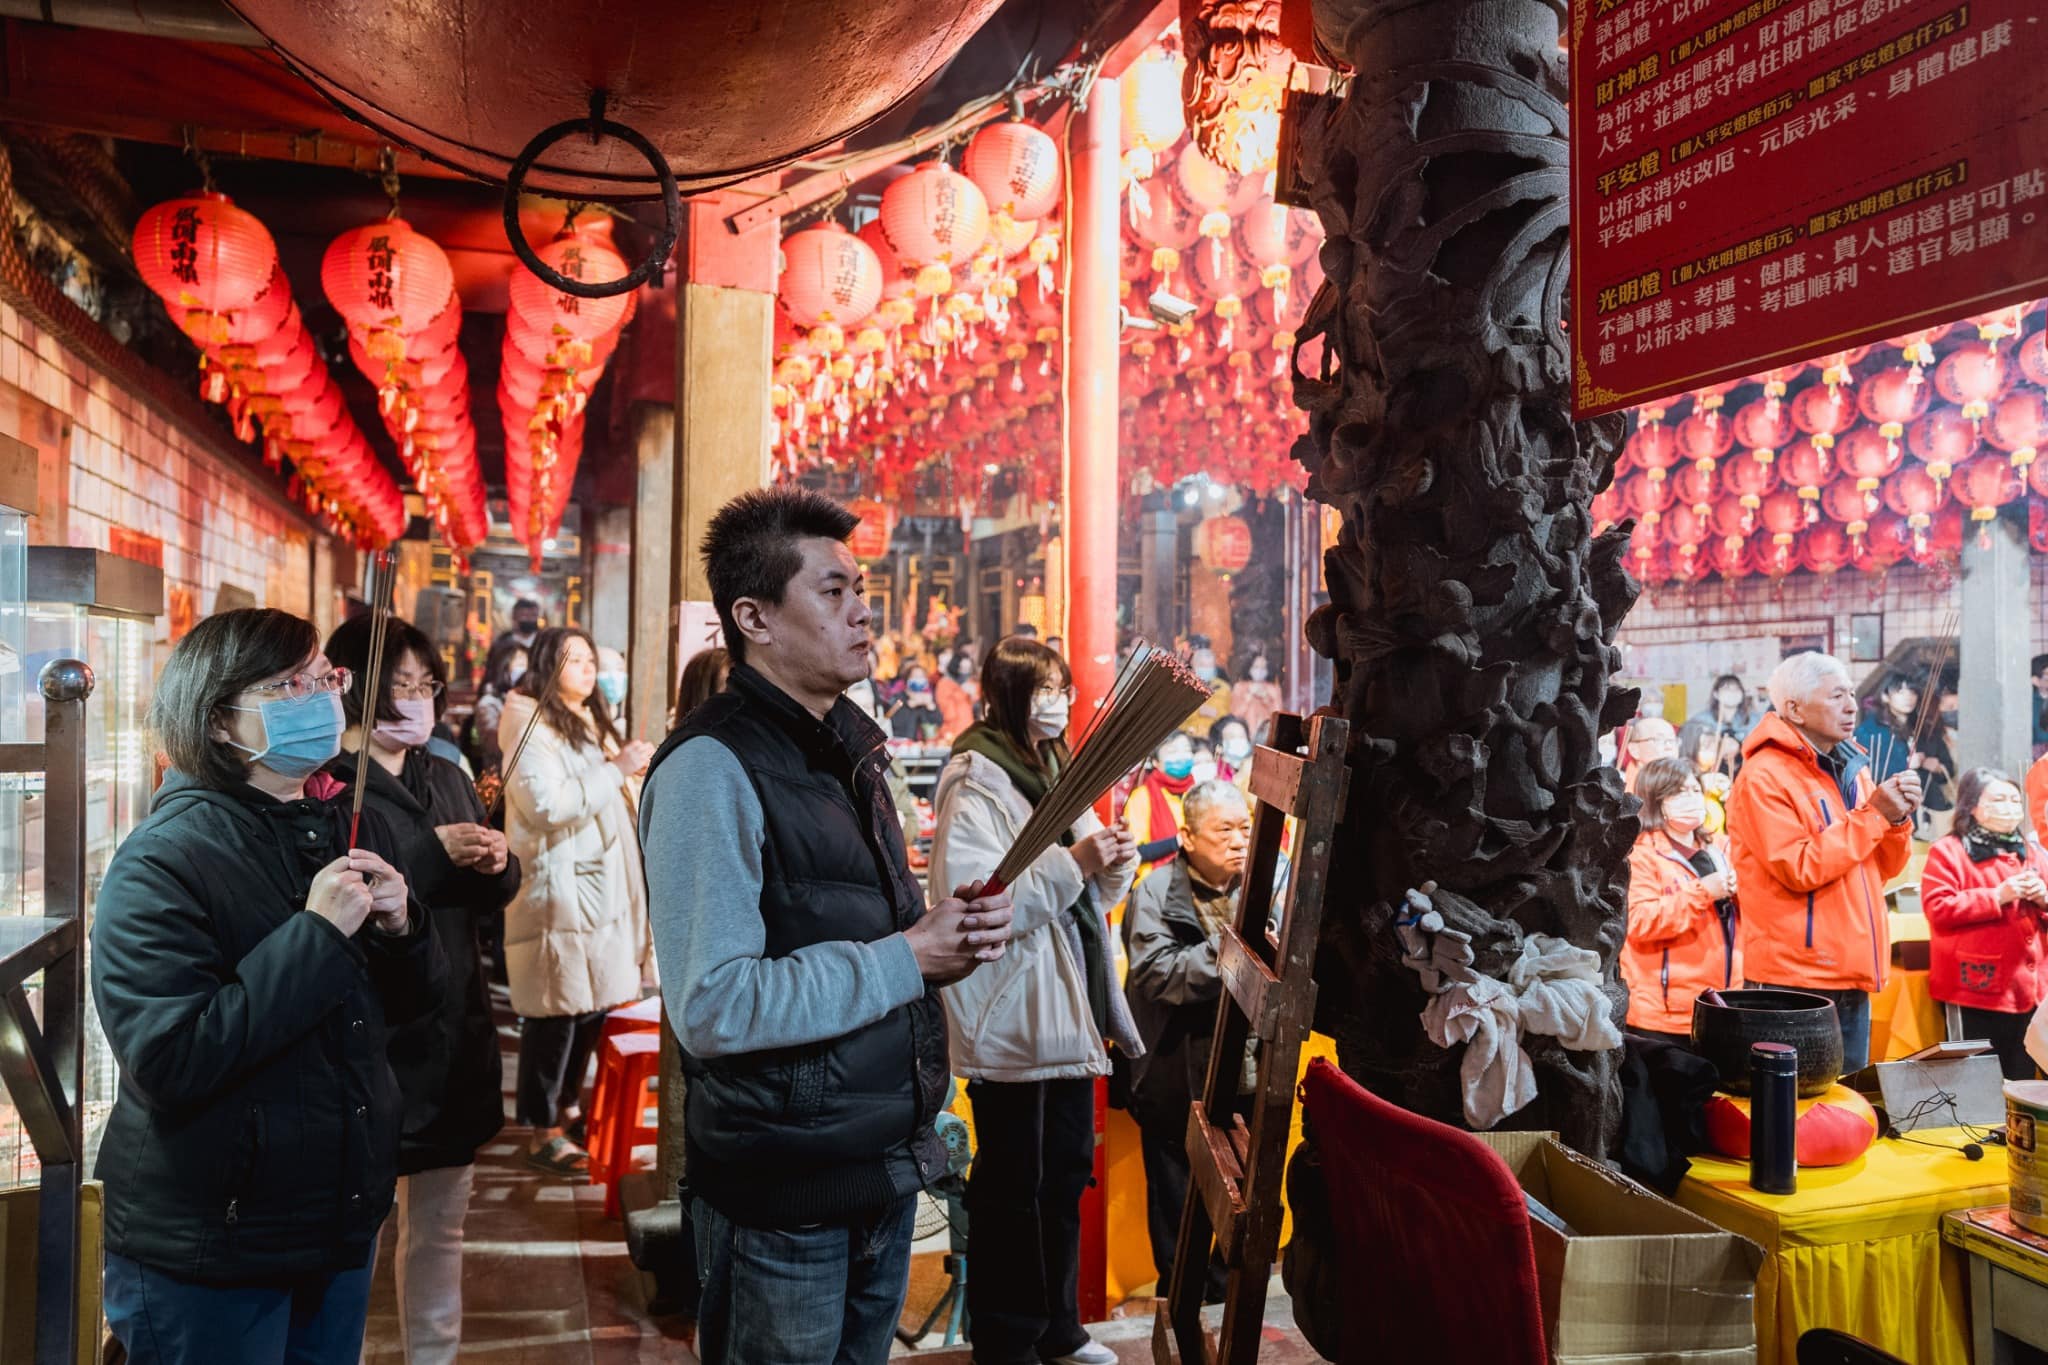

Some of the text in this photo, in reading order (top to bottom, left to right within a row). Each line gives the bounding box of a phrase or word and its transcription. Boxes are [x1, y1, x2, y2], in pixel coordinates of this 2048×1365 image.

[1597, 53, 1660, 106] 財神燈
[1597, 150, 1660, 195] 平安燈
[1598, 272, 1661, 313] 光明燈
